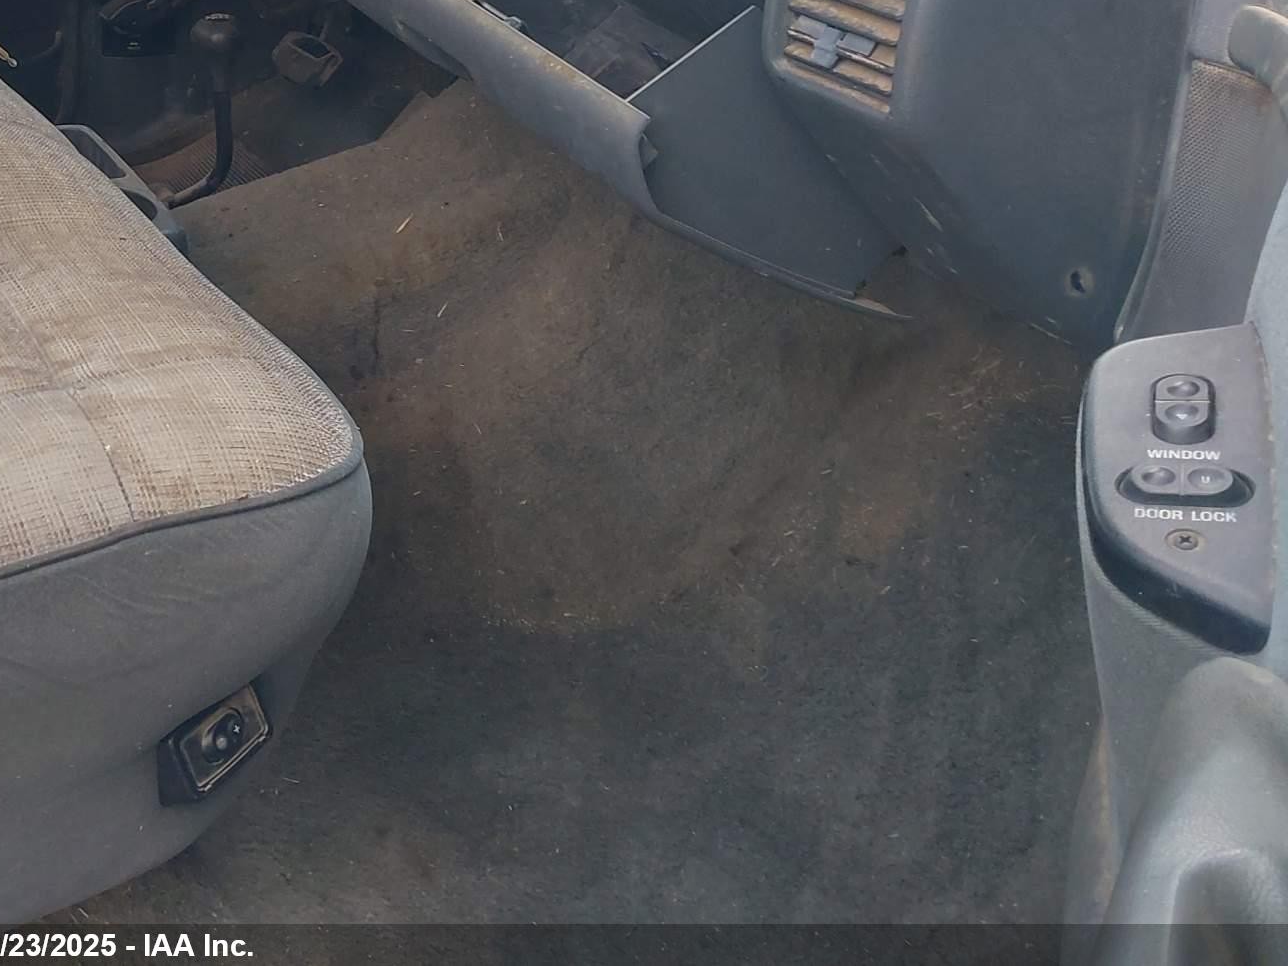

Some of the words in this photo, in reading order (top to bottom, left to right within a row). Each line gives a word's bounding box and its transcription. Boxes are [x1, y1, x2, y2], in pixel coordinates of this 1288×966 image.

[1147, 449, 1221, 461] WINDOW
[1134, 508, 1183, 521] DOOR
[1191, 510, 1237, 523] LOCK
